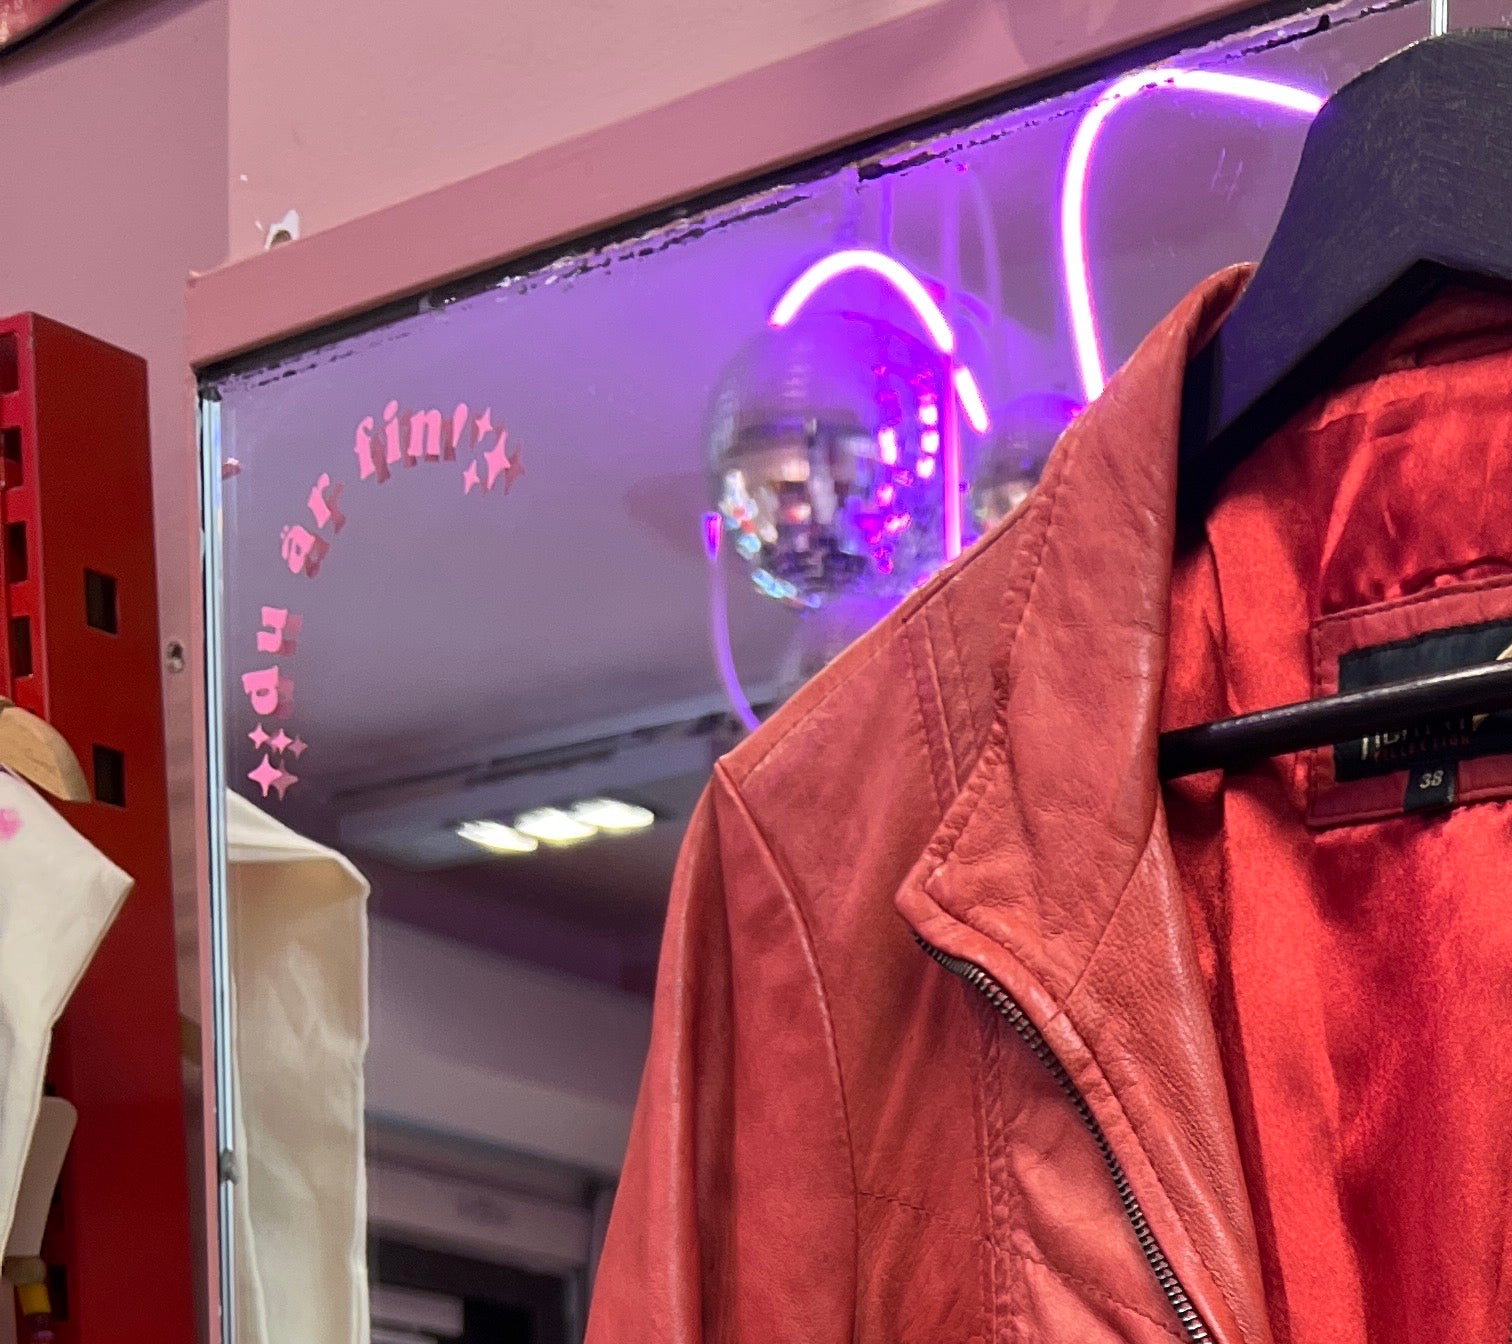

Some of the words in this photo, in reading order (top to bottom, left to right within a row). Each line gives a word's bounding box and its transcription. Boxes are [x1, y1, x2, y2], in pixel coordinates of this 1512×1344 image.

[241, 605, 289, 716] du
[353, 400, 469, 480] fin!
[1419, 769, 1445, 789] 38
